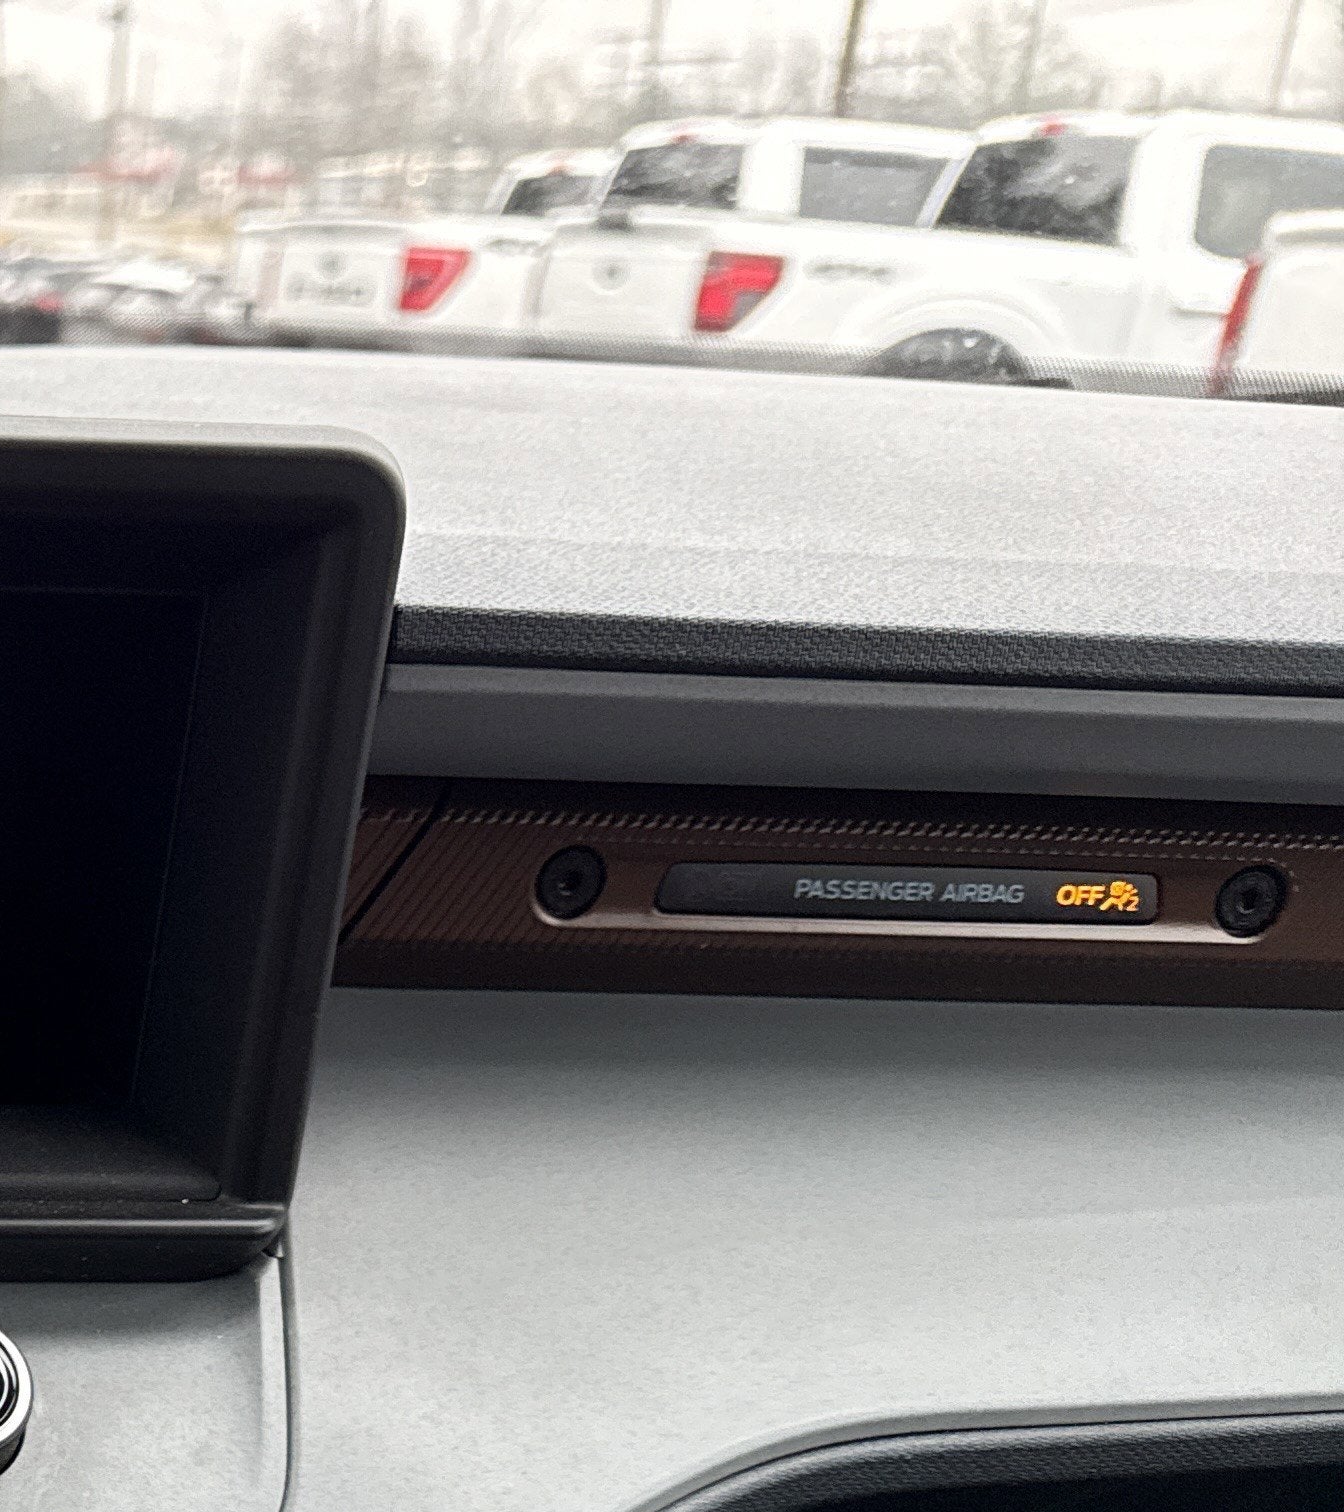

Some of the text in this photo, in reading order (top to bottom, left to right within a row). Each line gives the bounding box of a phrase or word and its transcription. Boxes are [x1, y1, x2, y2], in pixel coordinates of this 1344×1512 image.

[793, 878, 1026, 904] PASSENGER AIRBAG
[1056, 883, 1106, 906] OFF
